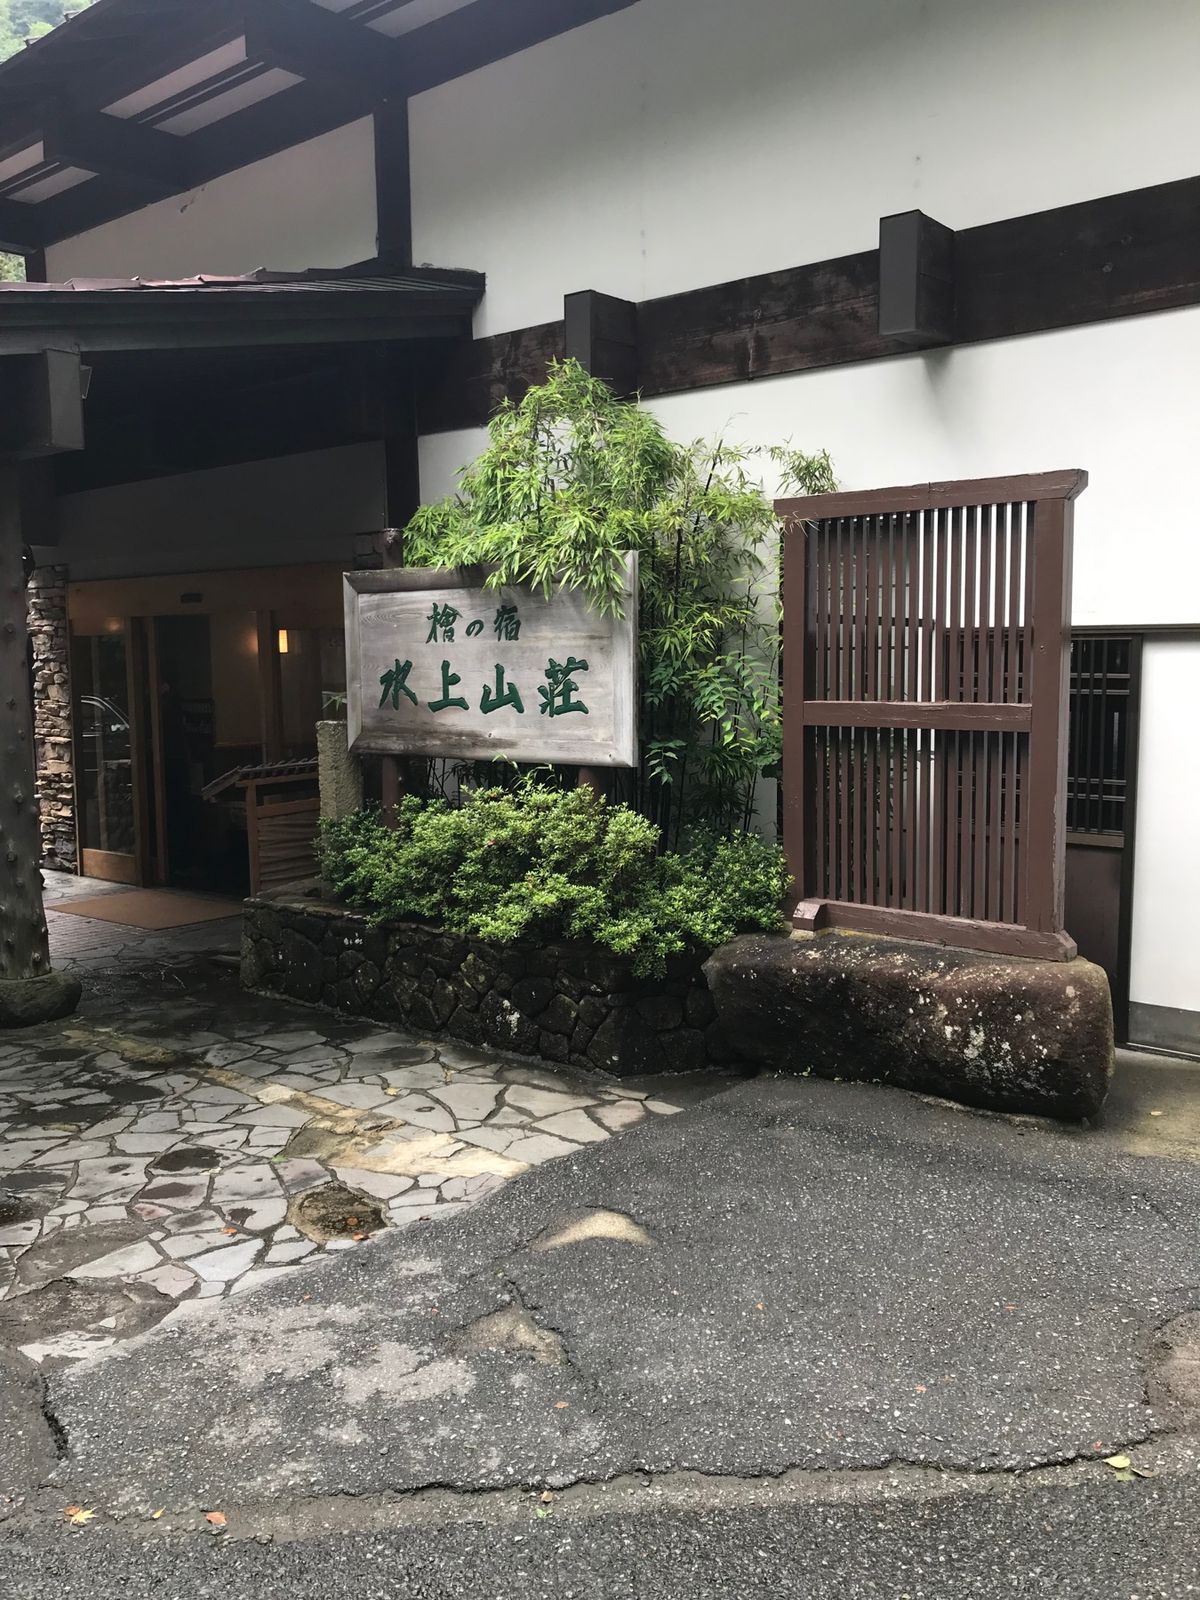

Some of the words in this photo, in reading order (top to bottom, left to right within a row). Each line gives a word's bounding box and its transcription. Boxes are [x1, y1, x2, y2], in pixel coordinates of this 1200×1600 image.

[426, 602, 522, 643] 檜の宿
[379, 657, 589, 718] 水上山荘
